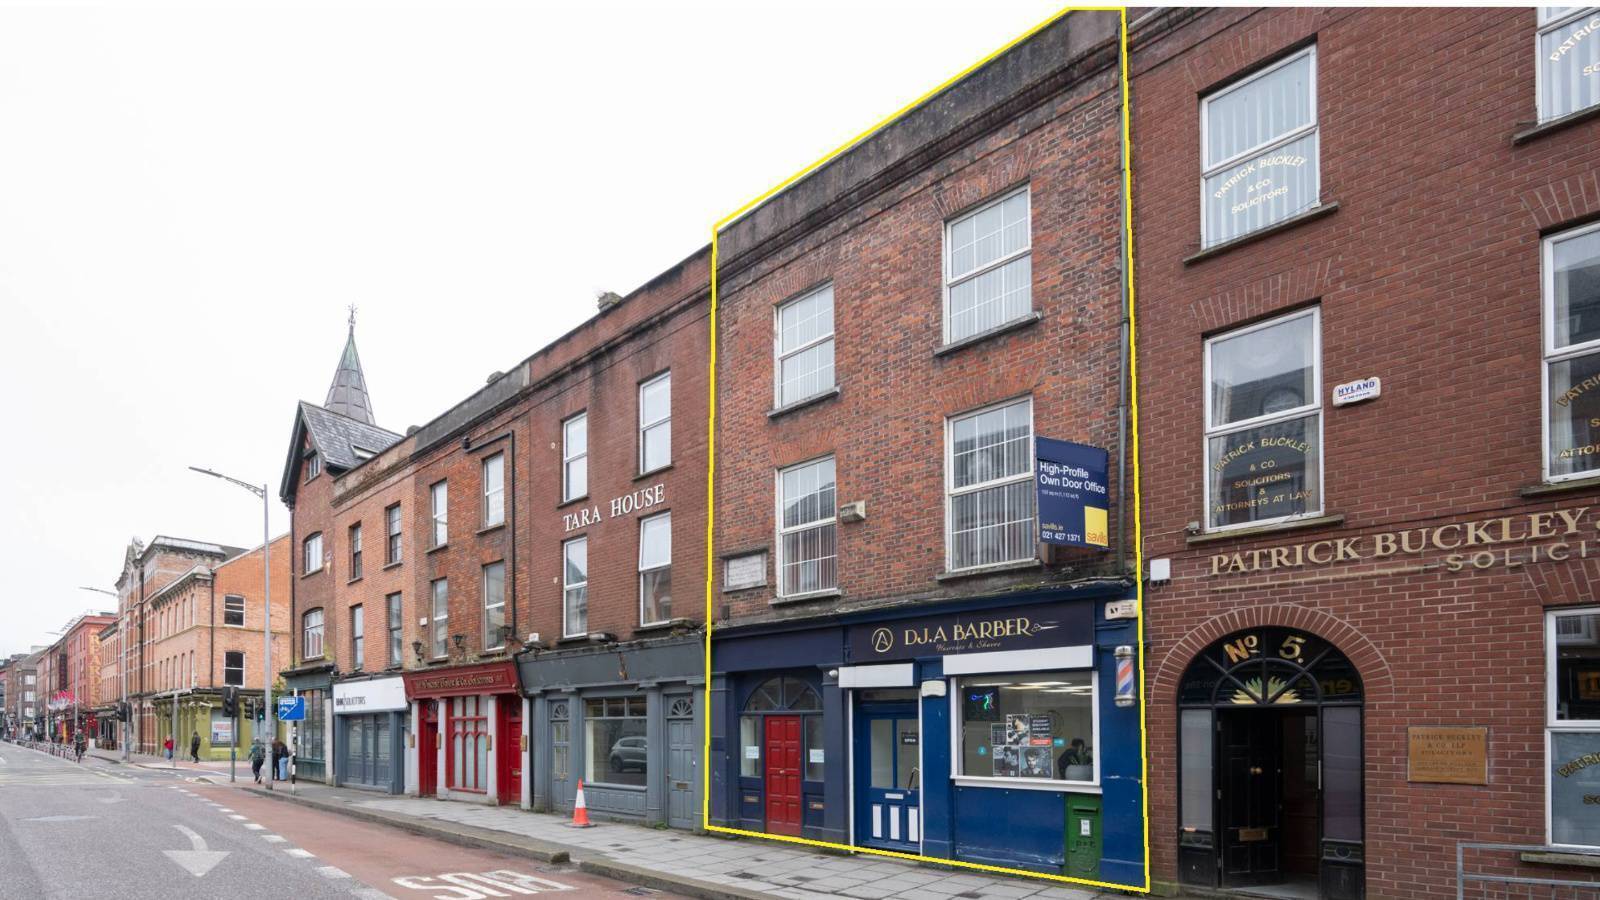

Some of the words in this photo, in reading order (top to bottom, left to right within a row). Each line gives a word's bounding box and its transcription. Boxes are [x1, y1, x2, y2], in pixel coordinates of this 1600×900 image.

[1214, 164, 1256, 199] PATRICK
[1260, 155, 1307, 168] BUCKLEY
[1231, 187, 1288, 214] SOLICITORS
[1338, 381, 1375, 397] HYLAND
[1214, 441, 1255, 473] PATRICK
[1261, 437, 1313, 456] BUCKLEY
[1040, 462, 1089, 479] High-Profile
[1234, 472, 1291, 489] SOLICITORS
[1040, 475, 1060, 487] Own
[1062, 477, 1082, 489] Door
[1084, 481, 1106, 494] Office
[563, 505, 602, 532] TARA
[610, 483, 665, 518] HOUSE
[1215, 496, 1269, 513] ATTORNEYS
[1273, 494, 1285, 504] AT
[1289, 489, 1314, 501] LAW
[1042, 531, 1053, 539] 021
[1055, 532, 1066, 540] 427
[1067, 534, 1081, 542] 1371
[1210, 536, 1363, 576] PATRICK
[1373, 507, 1590, 558] BUCKLEY
[1446, 540, 1600, 573] SOLICI
[953, 616, 1033, 641] BARBER
